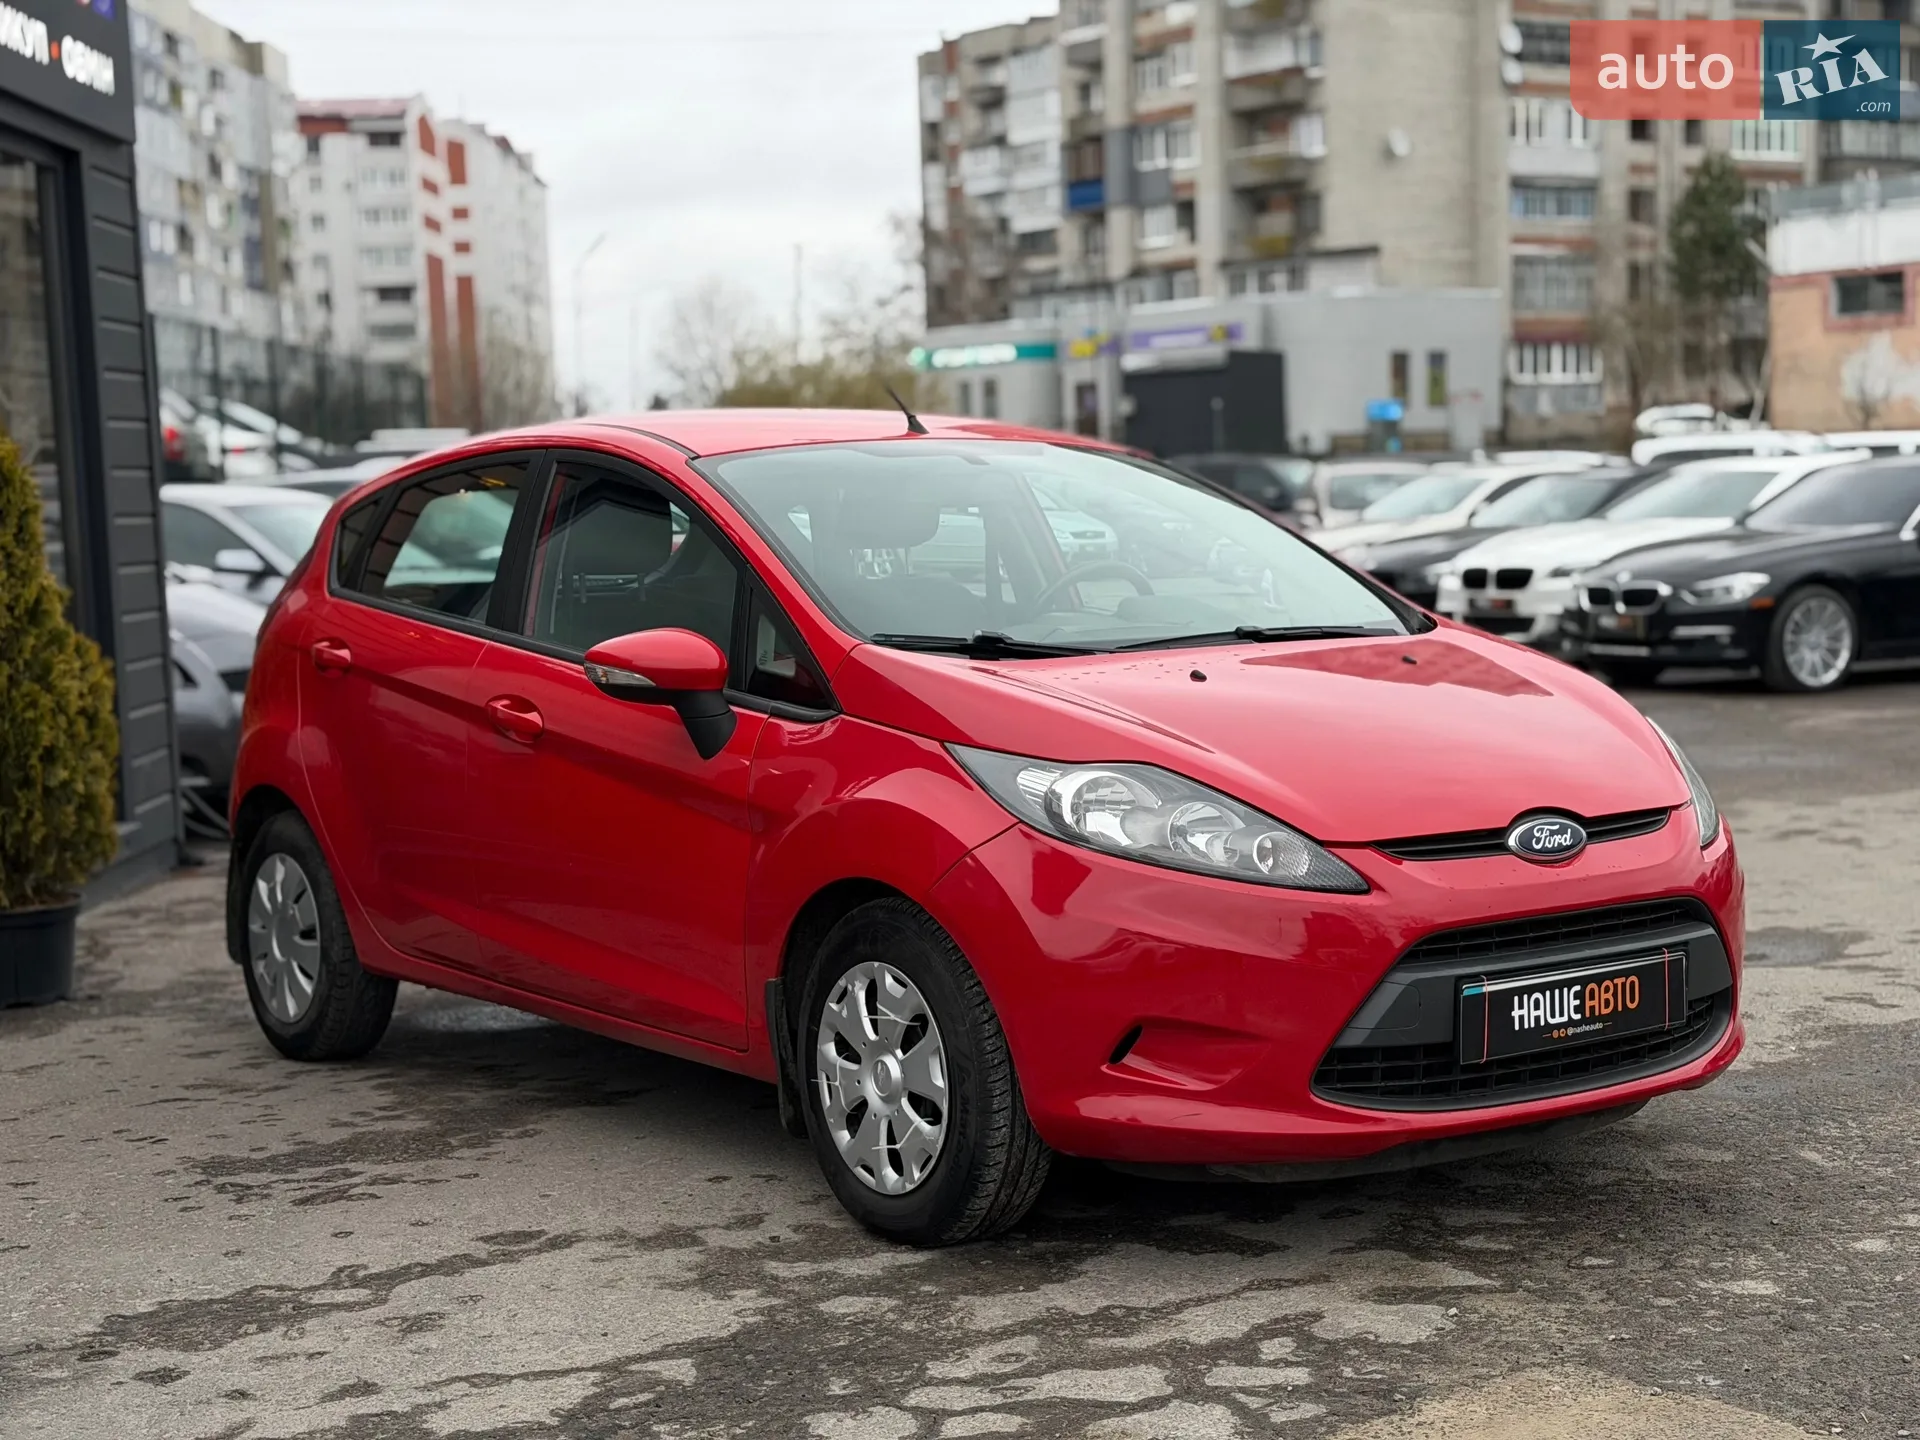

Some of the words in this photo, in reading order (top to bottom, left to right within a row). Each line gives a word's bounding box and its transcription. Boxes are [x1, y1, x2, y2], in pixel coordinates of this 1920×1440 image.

[1532, 824, 1573, 849] Ford
[1511, 985, 1581, 1030] НАШЕ
[1585, 975, 1640, 1018] АВТО
[1567, 1022, 1603, 1036] @nasheauto
